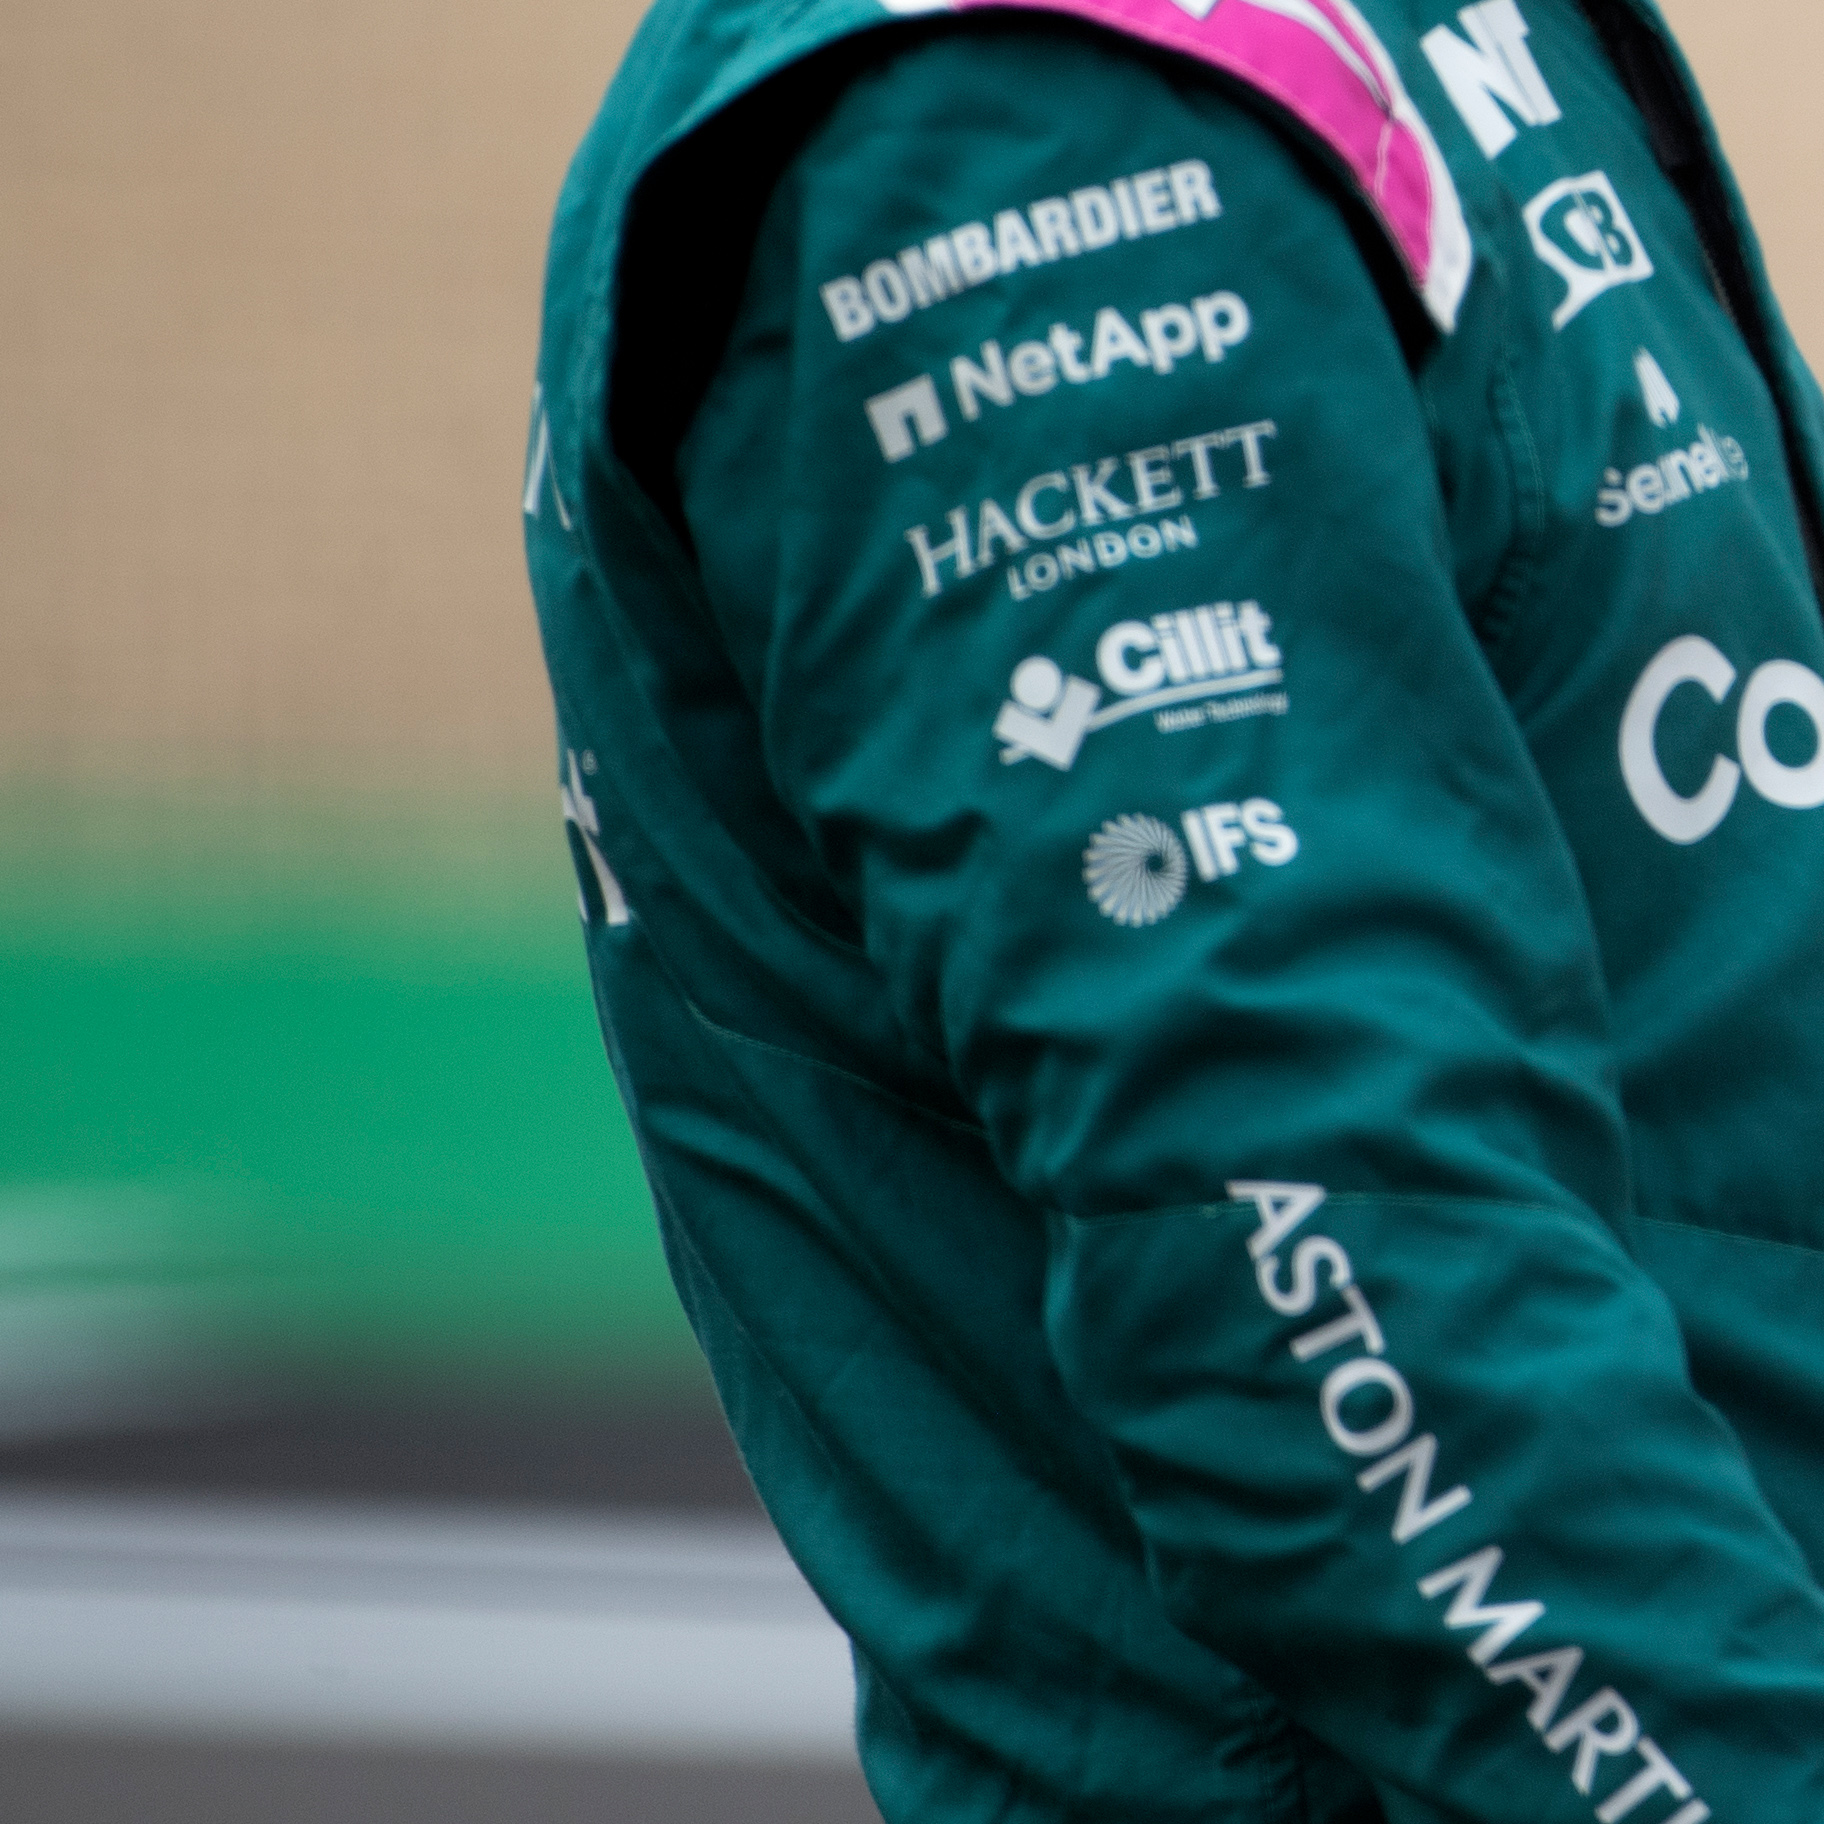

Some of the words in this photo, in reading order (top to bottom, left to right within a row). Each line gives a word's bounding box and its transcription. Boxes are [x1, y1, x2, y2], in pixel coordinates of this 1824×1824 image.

[819, 159, 1221, 343] BOMBARDIER
[949, 291, 1250, 422] NetApp
[905, 420, 1277, 598] HACKETT
[1004, 515, 1199, 601] LONDON
[1096, 599, 1282, 696] Cillit
[1180, 798, 1299, 882] IFS
[1224, 1179, 1474, 1545] ASTON
[1416, 1546, 1712, 1824] MART
